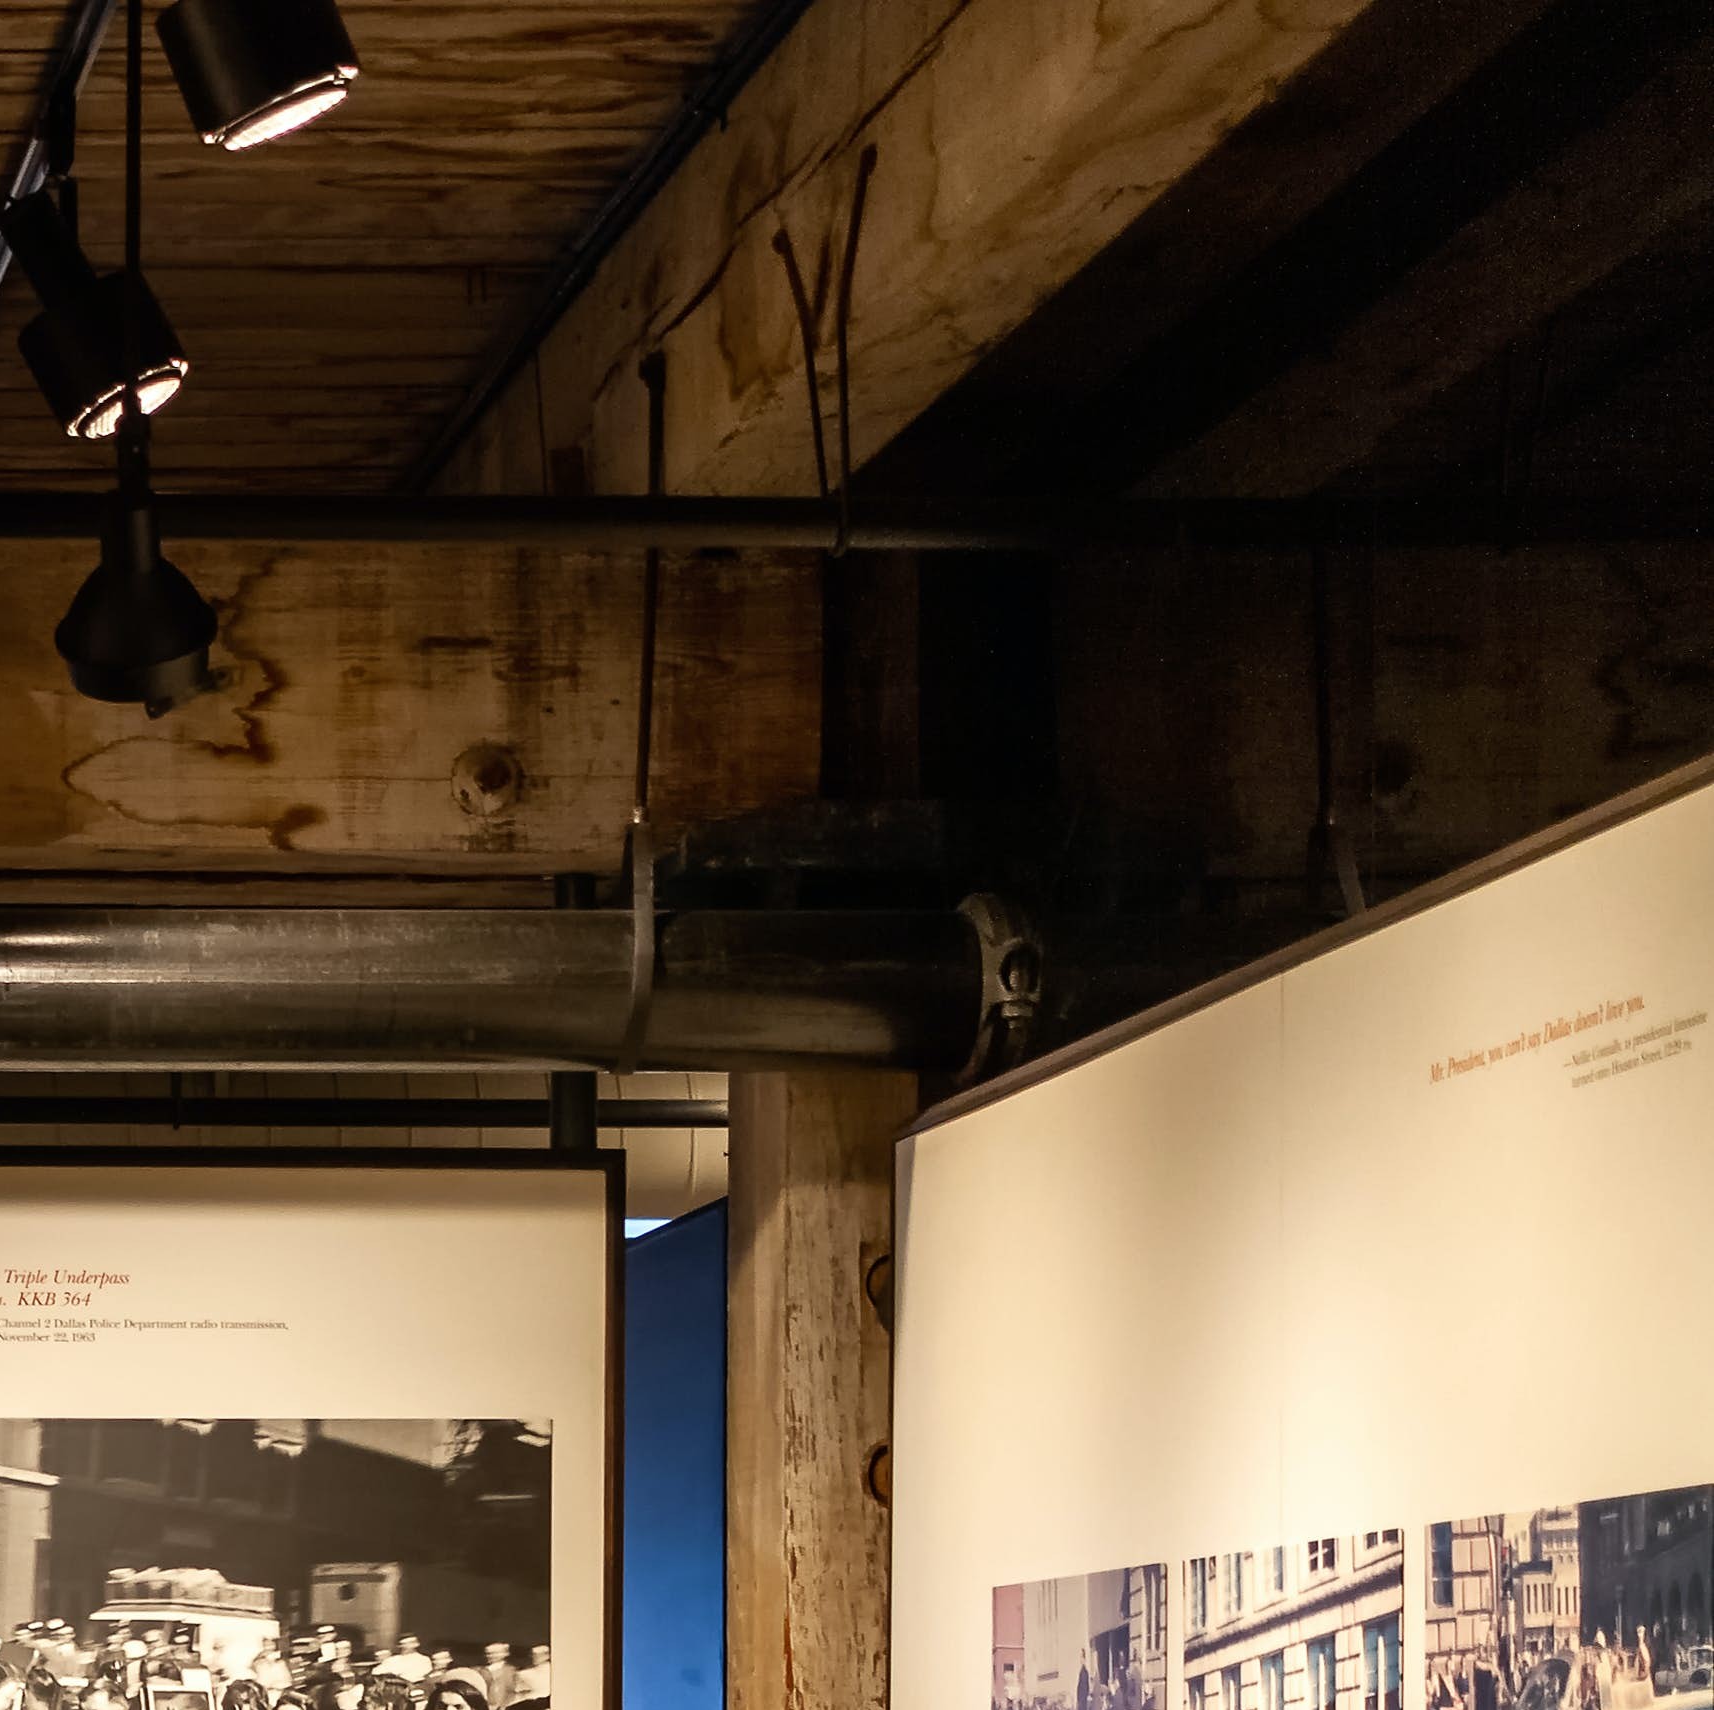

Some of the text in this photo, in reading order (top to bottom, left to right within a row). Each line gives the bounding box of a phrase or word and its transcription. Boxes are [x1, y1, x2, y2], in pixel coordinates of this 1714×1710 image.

[4, 1268, 48, 1289] Triple
[53, 1269, 131, 1289] Underpass
[17, 1291, 56, 1306] KKB
[61, 1291, 92, 1307] 364
[54, 1318, 87, 1329] Dallas
[89, 1318, 121, 1329] Police
[124, 1318, 187, 1331] Department
[190, 1319, 218, 1329] radio
[220, 1319, 289, 1330] transmission,
